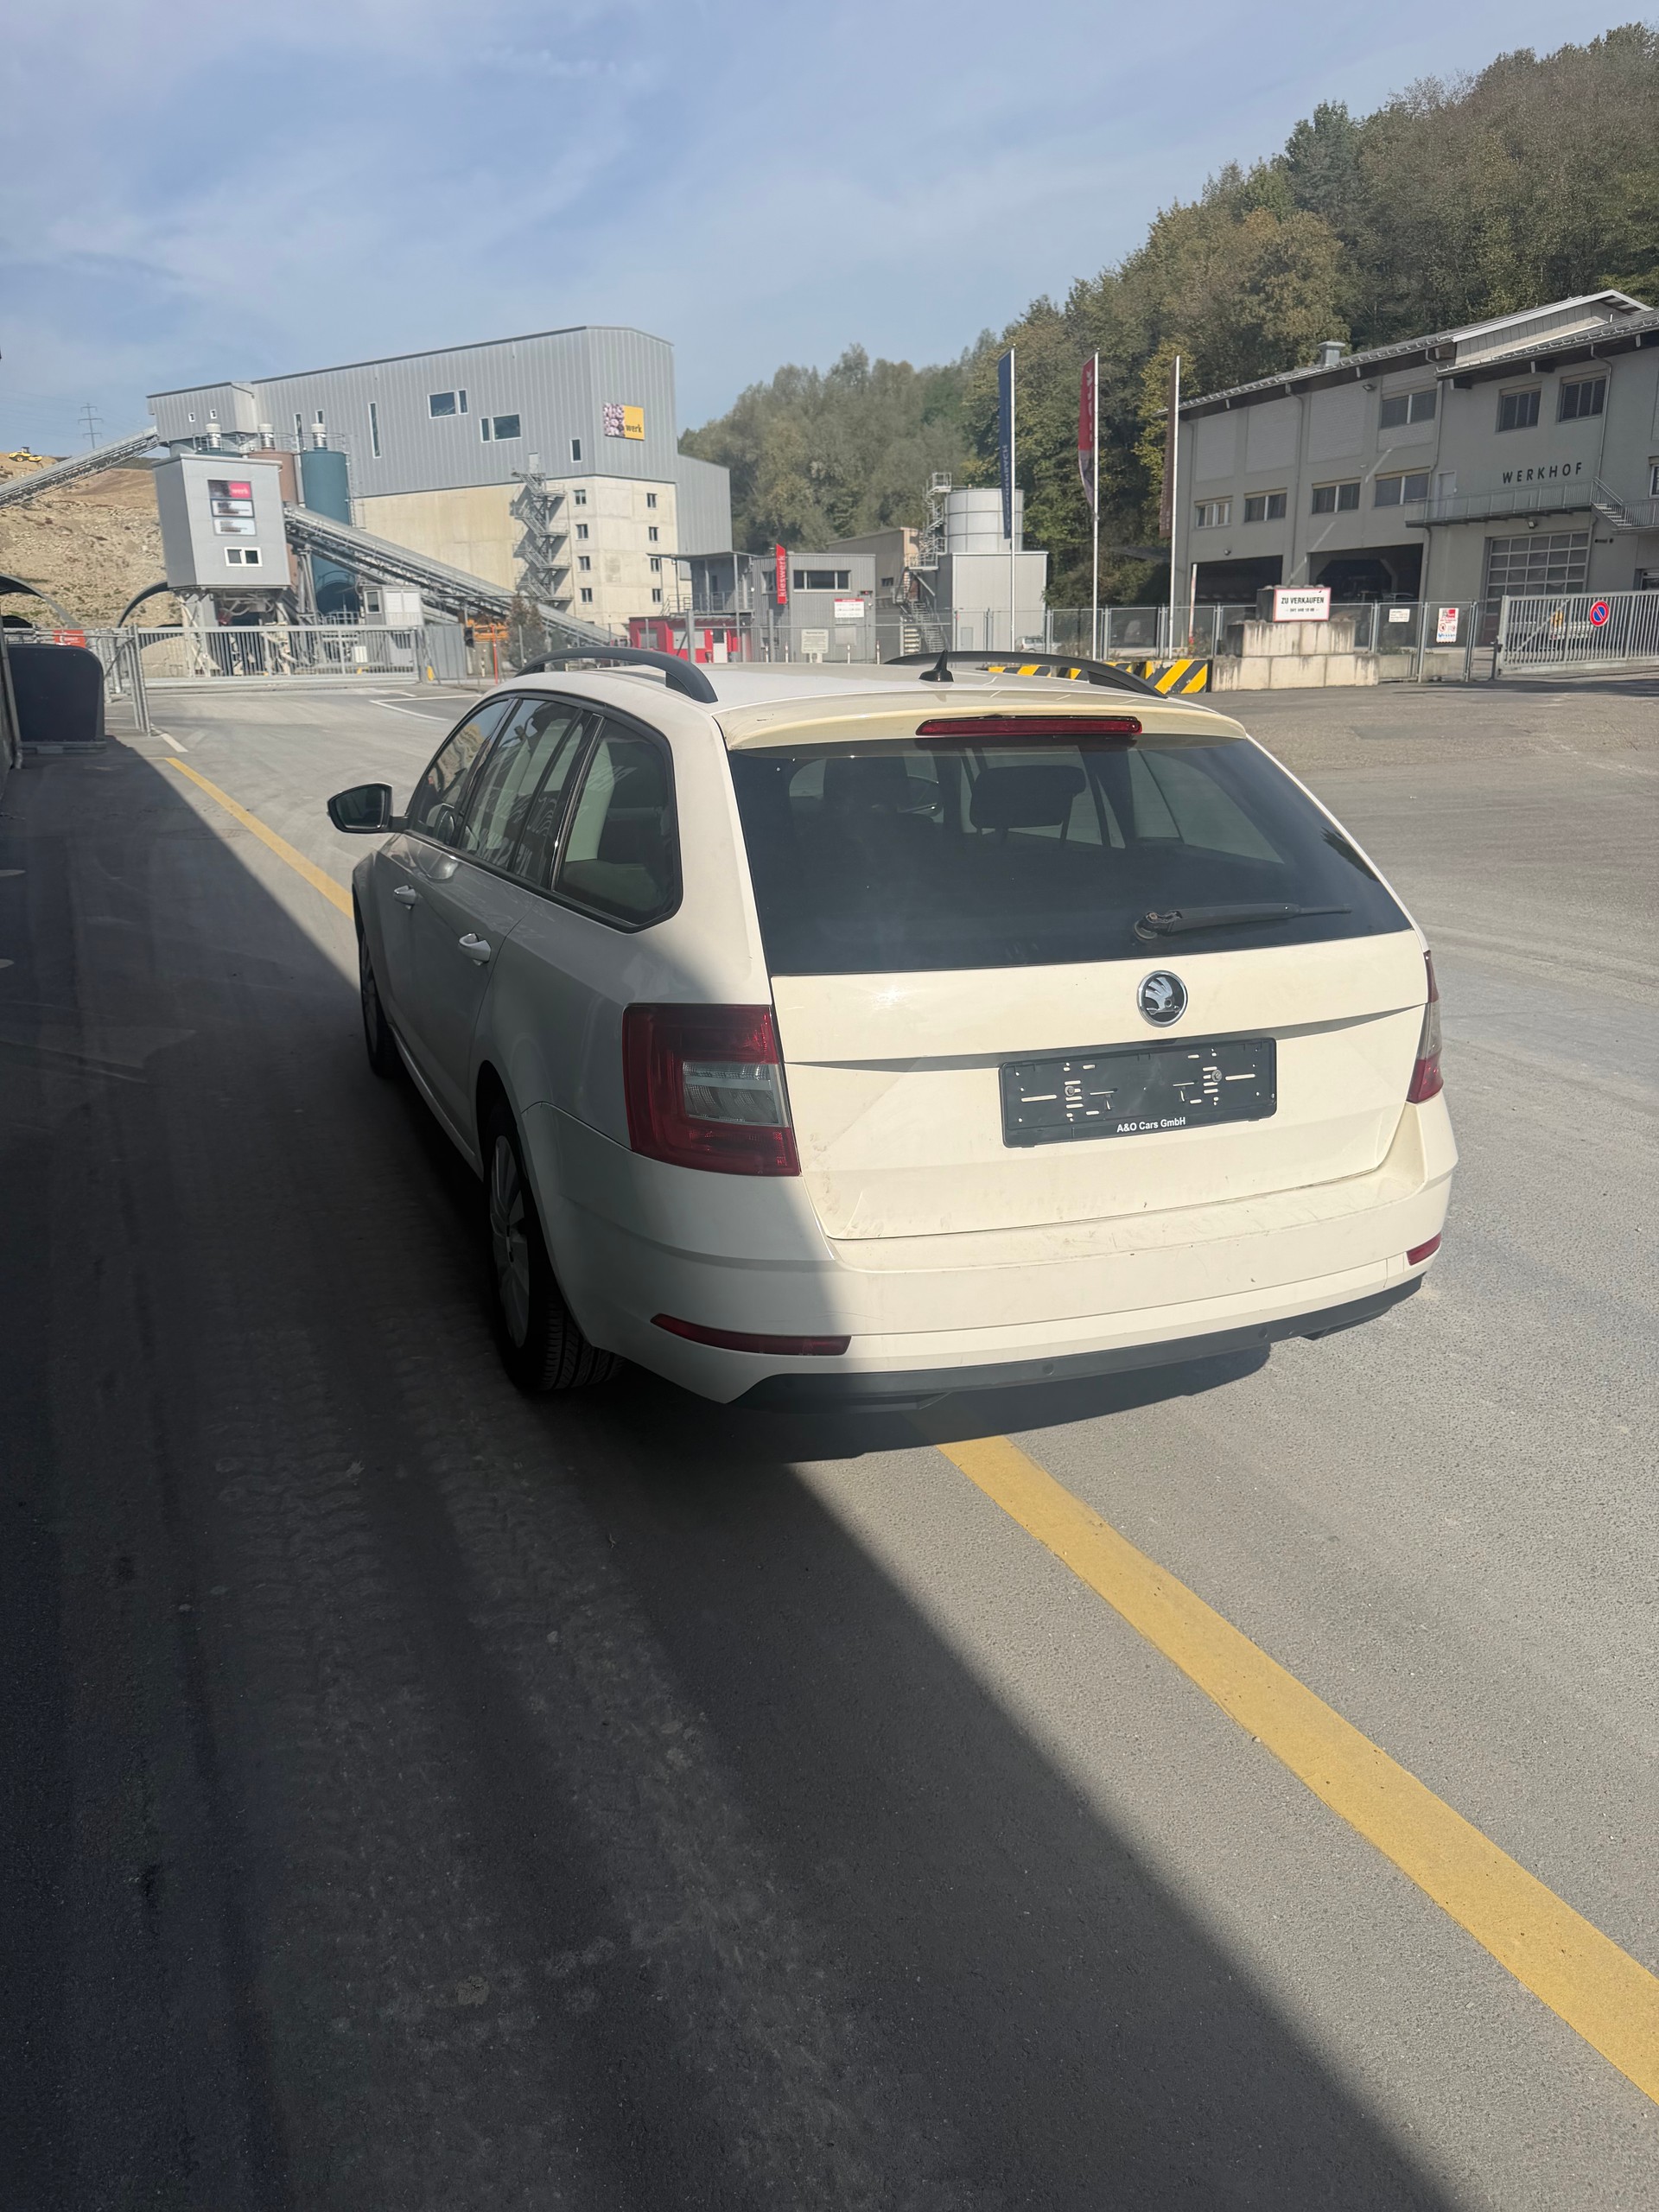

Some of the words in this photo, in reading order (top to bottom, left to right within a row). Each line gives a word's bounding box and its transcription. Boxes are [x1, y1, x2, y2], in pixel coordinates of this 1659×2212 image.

[626, 424, 642, 433] werk
[1503, 461, 1582, 484] WERKHOF
[778, 556, 786, 597] kieswerk
[1116, 1122, 1137, 1133] A&O
[1139, 1121, 1159, 1130] Cars
[1160, 1116, 1185, 1128] GmbH
